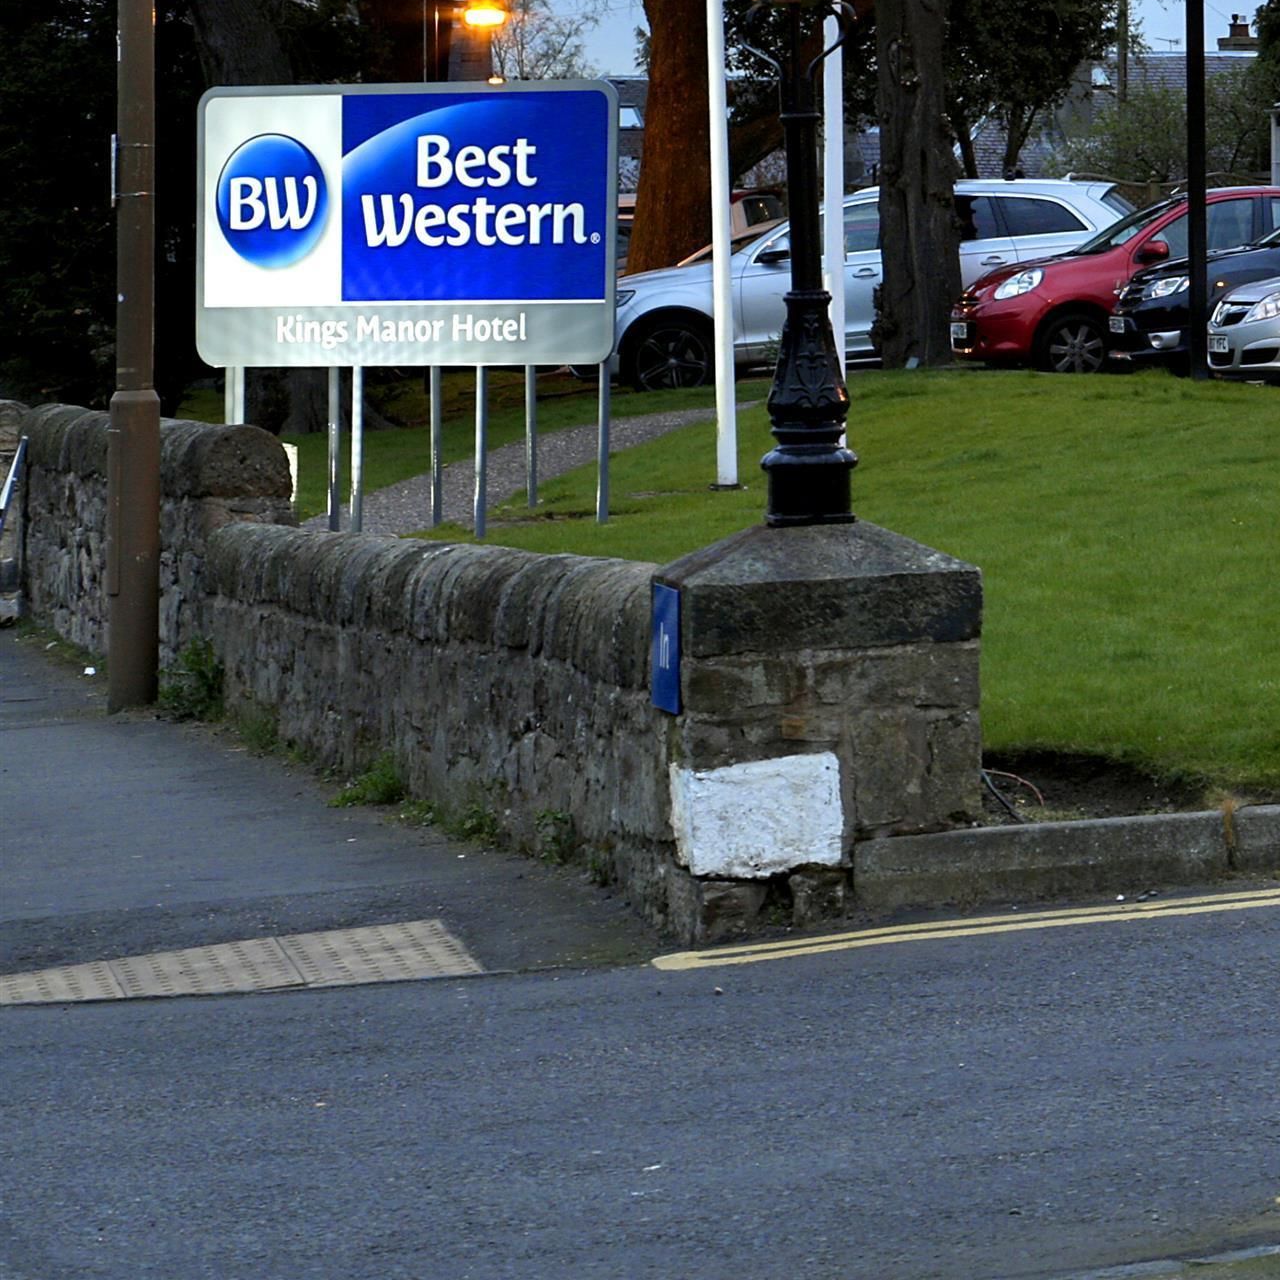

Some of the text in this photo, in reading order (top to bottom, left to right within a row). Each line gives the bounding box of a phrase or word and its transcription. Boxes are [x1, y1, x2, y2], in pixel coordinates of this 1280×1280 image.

[416, 134, 538, 188] Best
[229, 175, 318, 231] BW
[361, 192, 588, 247] Western
[276, 312, 527, 350] Kings Manor Hotel
[660, 621, 670, 670] In
